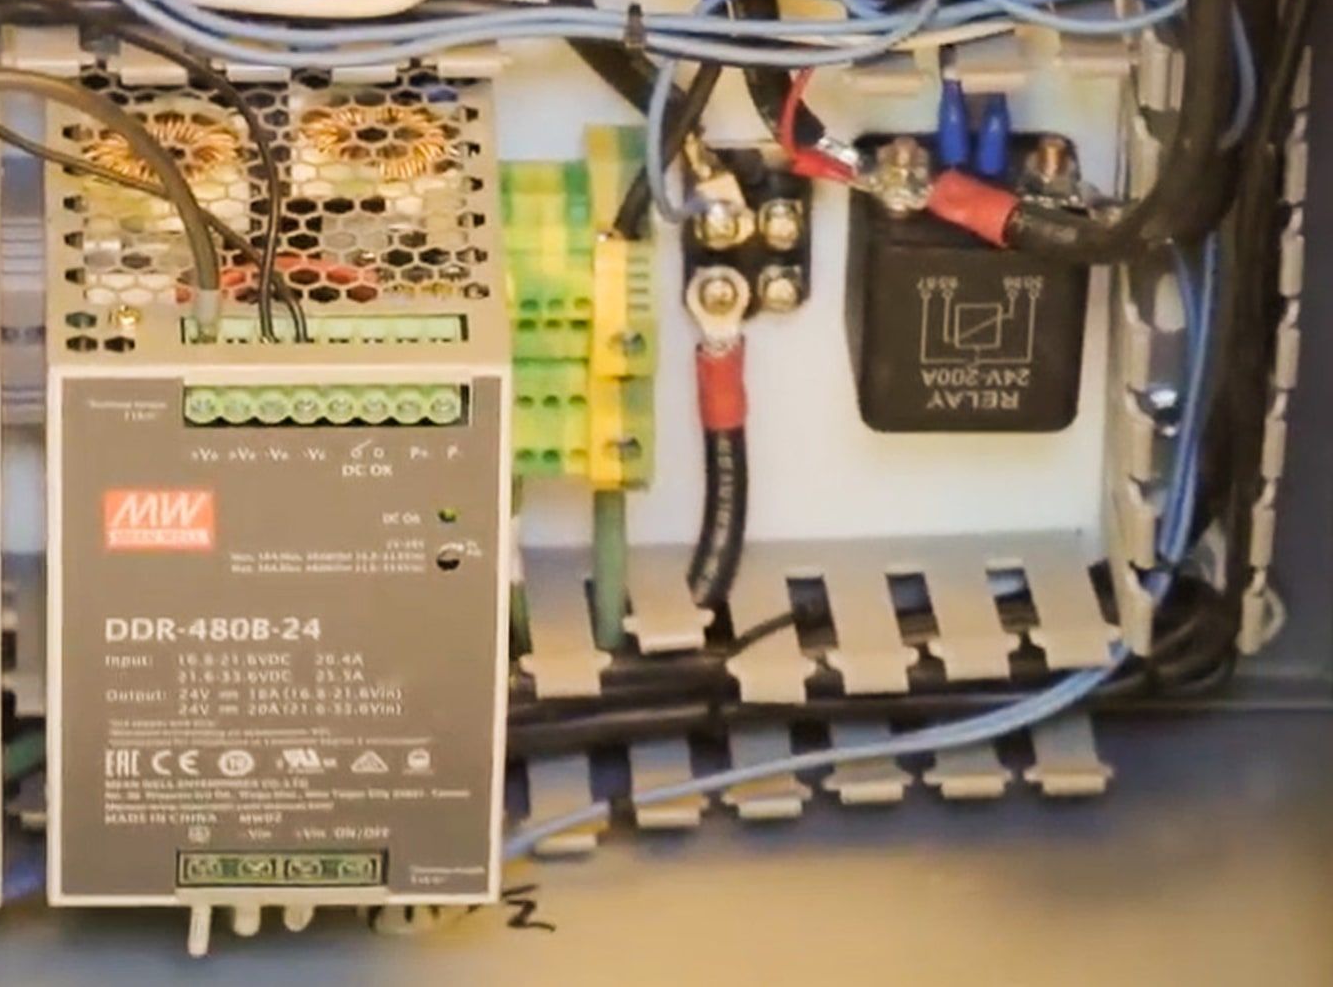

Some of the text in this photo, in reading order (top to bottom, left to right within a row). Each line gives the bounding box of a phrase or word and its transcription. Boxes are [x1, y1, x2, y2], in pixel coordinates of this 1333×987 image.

[926, 389, 1020, 410] RELAY
[341, 464, 364, 477] DC
[105, 617, 322, 642] DDR-480B-24
